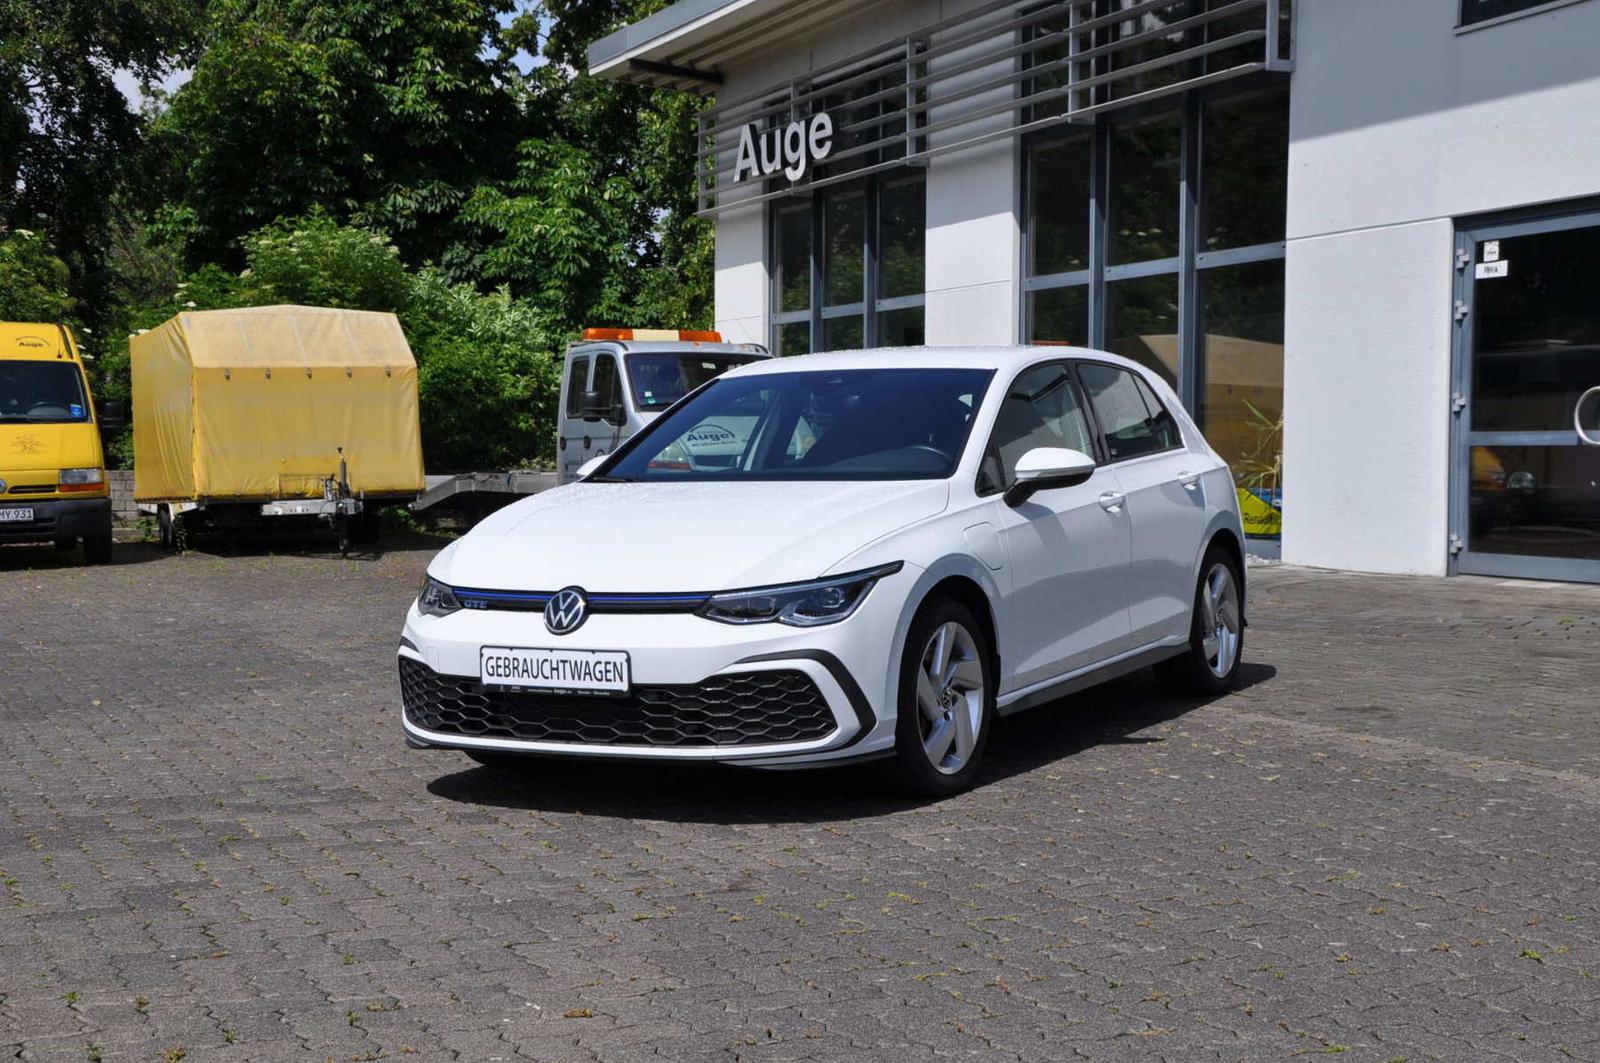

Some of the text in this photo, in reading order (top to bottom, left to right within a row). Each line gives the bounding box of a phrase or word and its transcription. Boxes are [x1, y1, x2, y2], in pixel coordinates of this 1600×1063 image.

[734, 112, 833, 183] Auge
[687, 432, 730, 441] Auge
[14, 509, 32, 519] 931
[464, 600, 488, 609] GTE
[485, 656, 624, 683] GEBRAUCHTWAGEN
